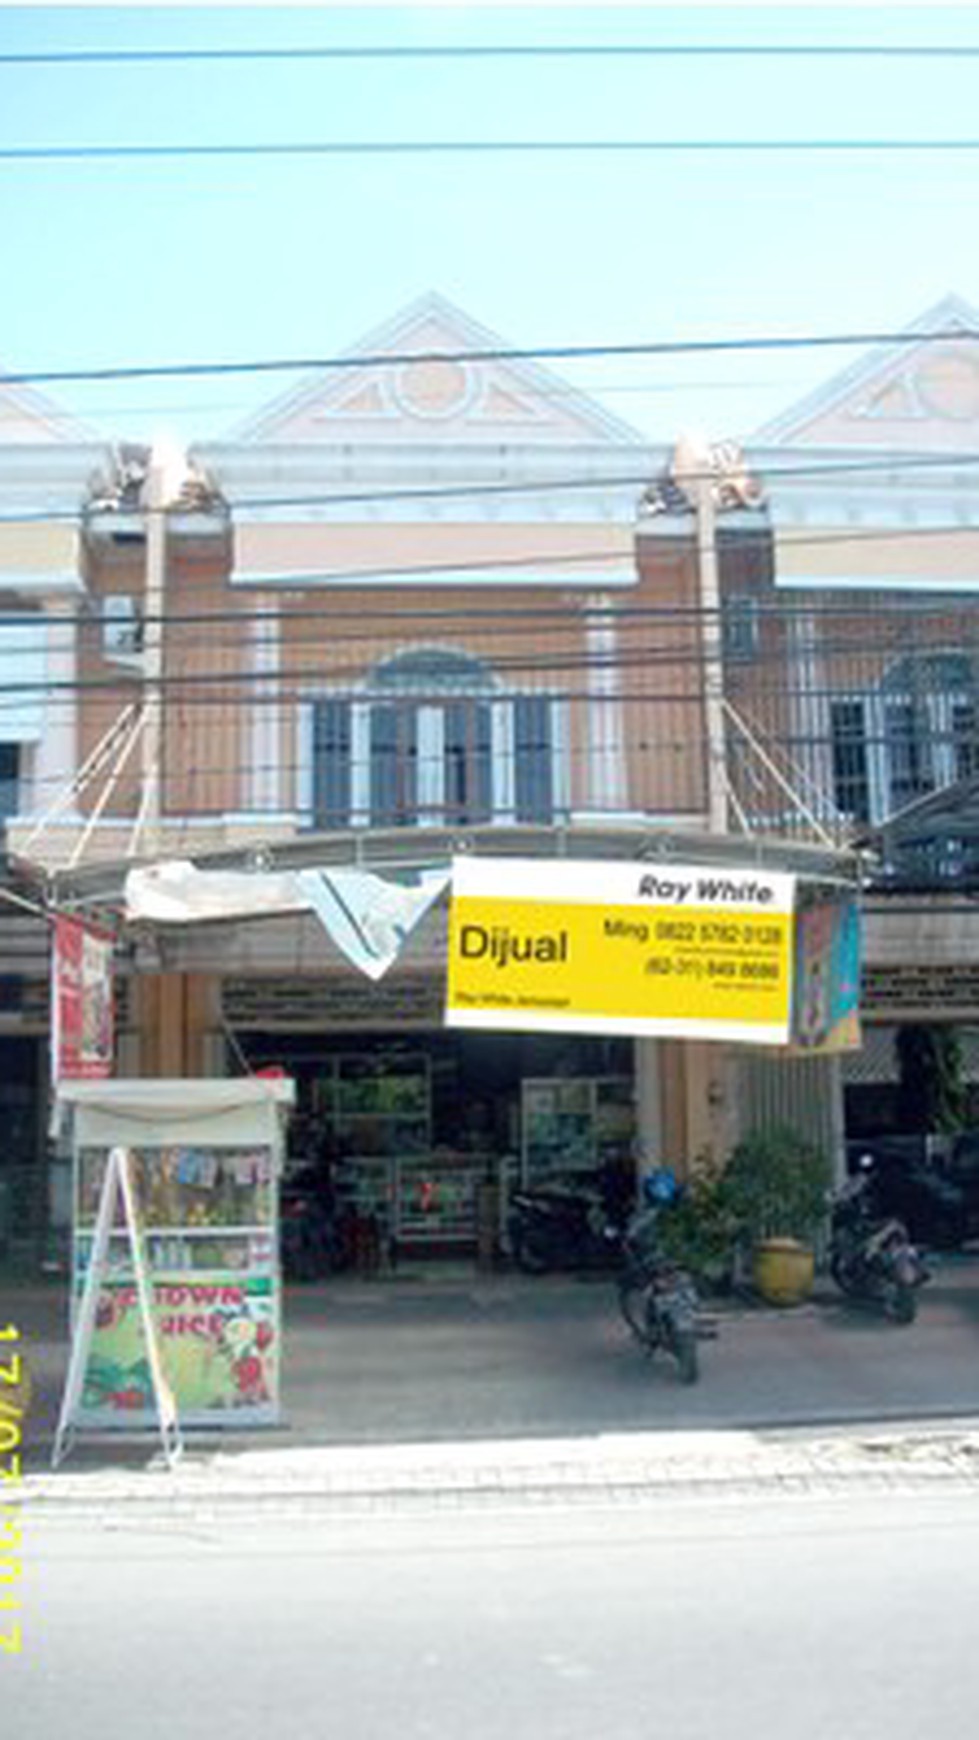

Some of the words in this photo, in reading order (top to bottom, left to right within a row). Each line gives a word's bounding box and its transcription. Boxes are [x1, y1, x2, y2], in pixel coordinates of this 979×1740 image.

[638, 874, 691, 903] Ray
[696, 879, 774, 904] White
[459, 924, 568, 968] Dijual
[604, 919, 649, 945] Ming
